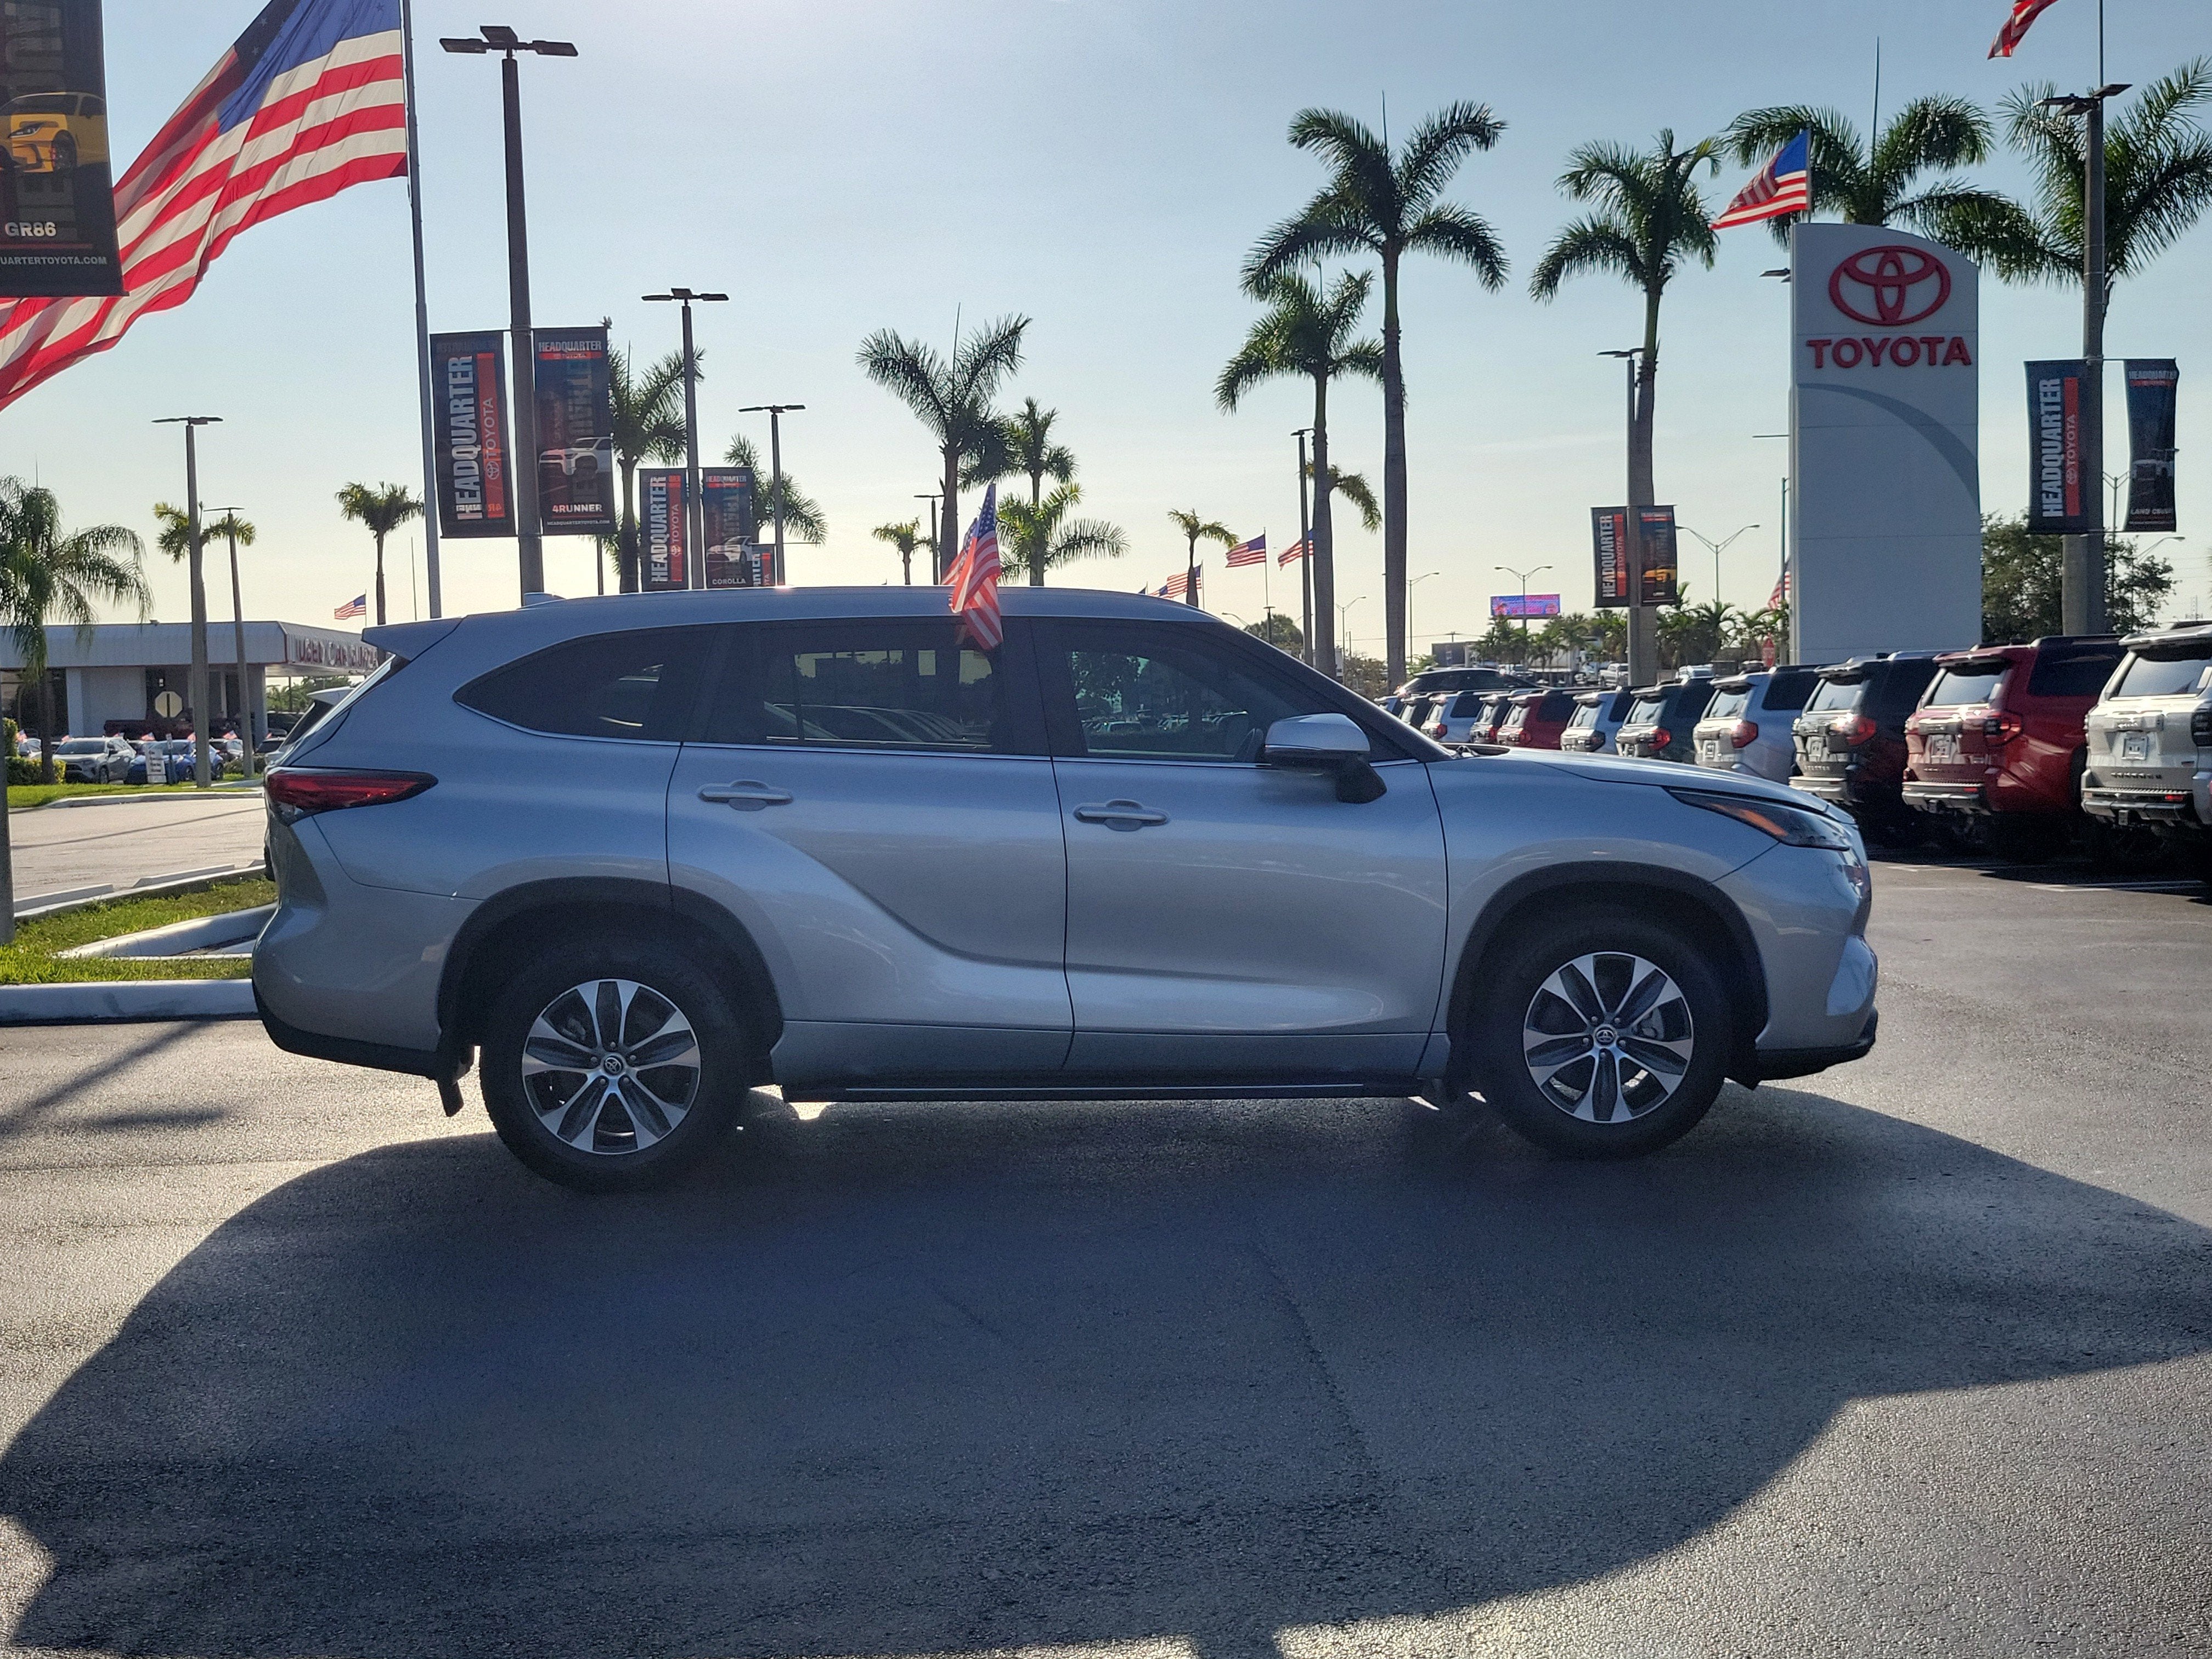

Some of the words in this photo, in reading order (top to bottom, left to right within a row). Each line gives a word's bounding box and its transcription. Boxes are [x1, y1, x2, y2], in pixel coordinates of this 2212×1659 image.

[5, 222, 57, 237] GR86
[538, 341, 602, 352] HEADQUARTER
[1806, 336, 1972, 369] TOYOTA
[448, 356, 482, 520] HEADQUARTER
[483, 397, 496, 459] TOYOTA
[2039, 379, 2064, 517] HEADQUARTER
[2066, 414, 2076, 466] TOYOTA
[552, 504, 602, 513] 4RUNNER
[650, 477, 670, 582] HEADQUARTER
[672, 504, 680, 543] TOYOTA
[1599, 515, 1616, 597] HEADQUARTER
